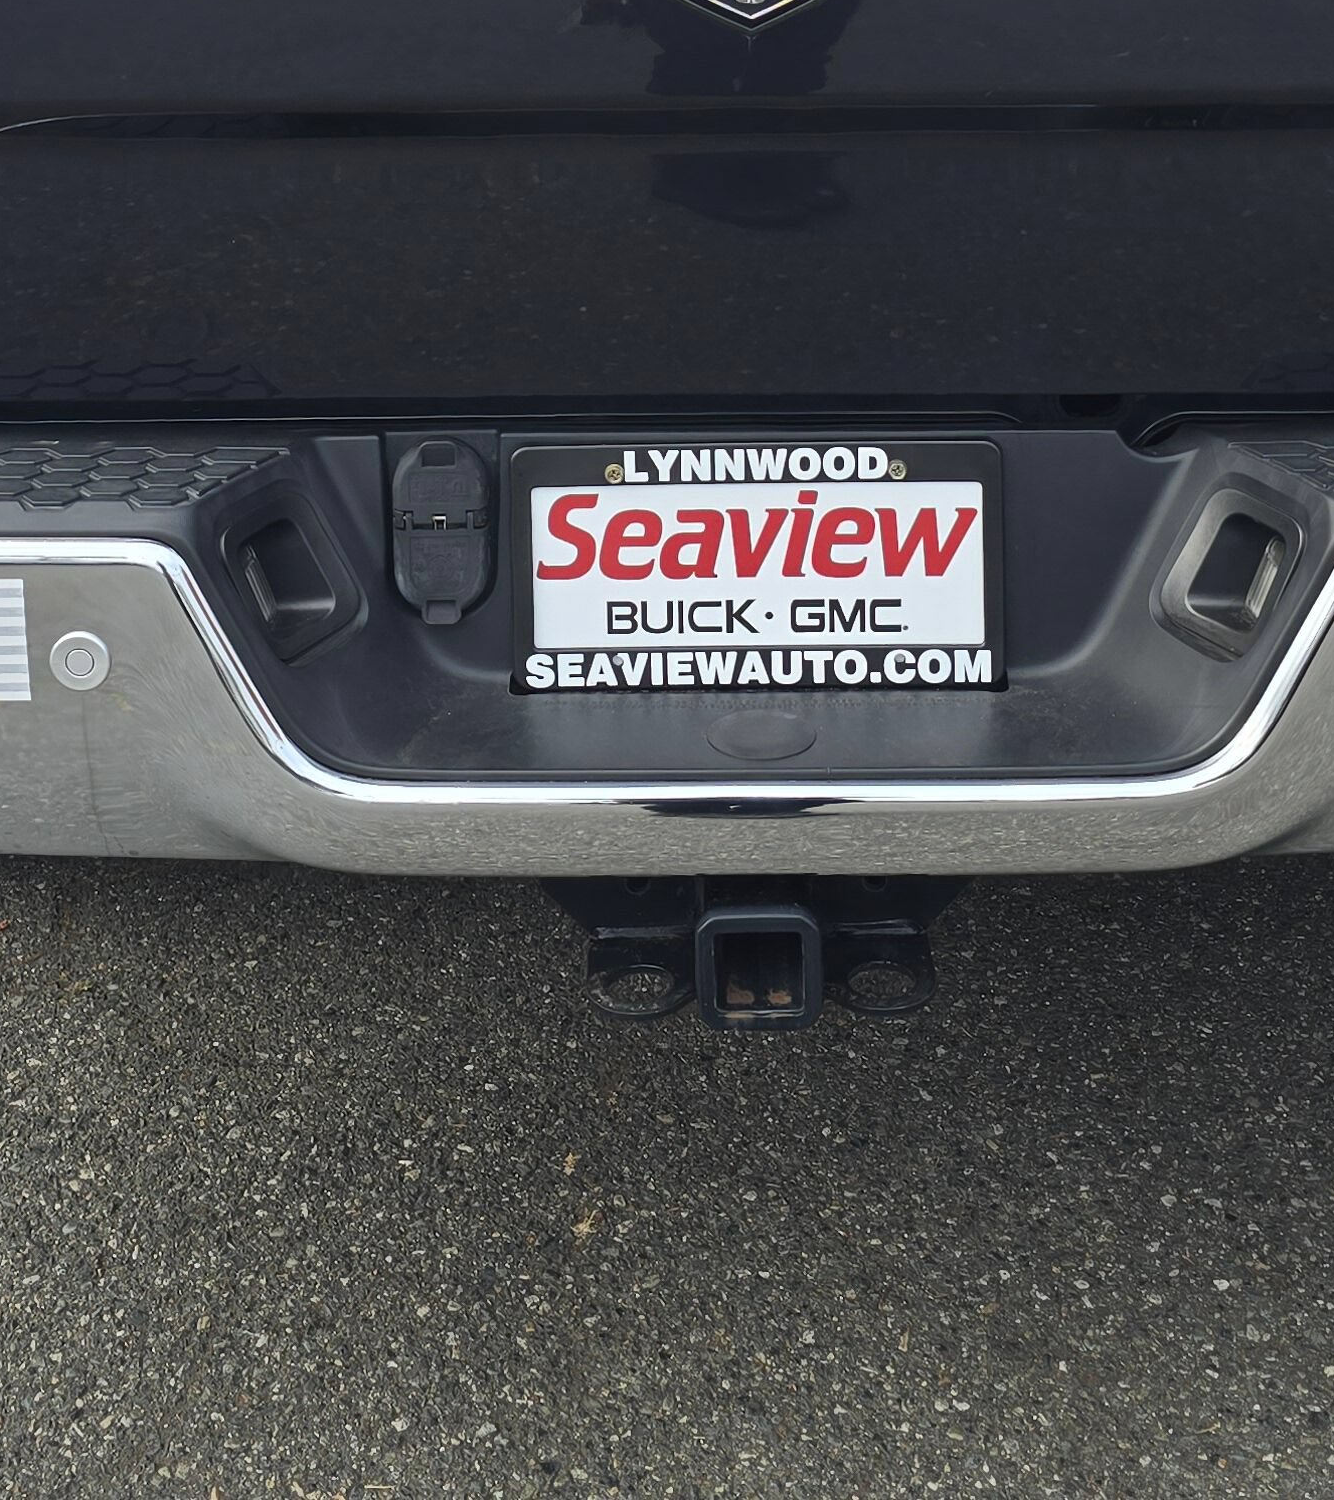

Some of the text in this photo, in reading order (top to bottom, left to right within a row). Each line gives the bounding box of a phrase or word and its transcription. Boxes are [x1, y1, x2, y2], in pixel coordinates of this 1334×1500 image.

[623, 446, 889, 484] LYNNWOOD
[535, 490, 978, 581] Seaview
[607, 598, 903, 635] BUICK GMC
[525, 648, 993, 688] SEAVIEWAUTO.COM
